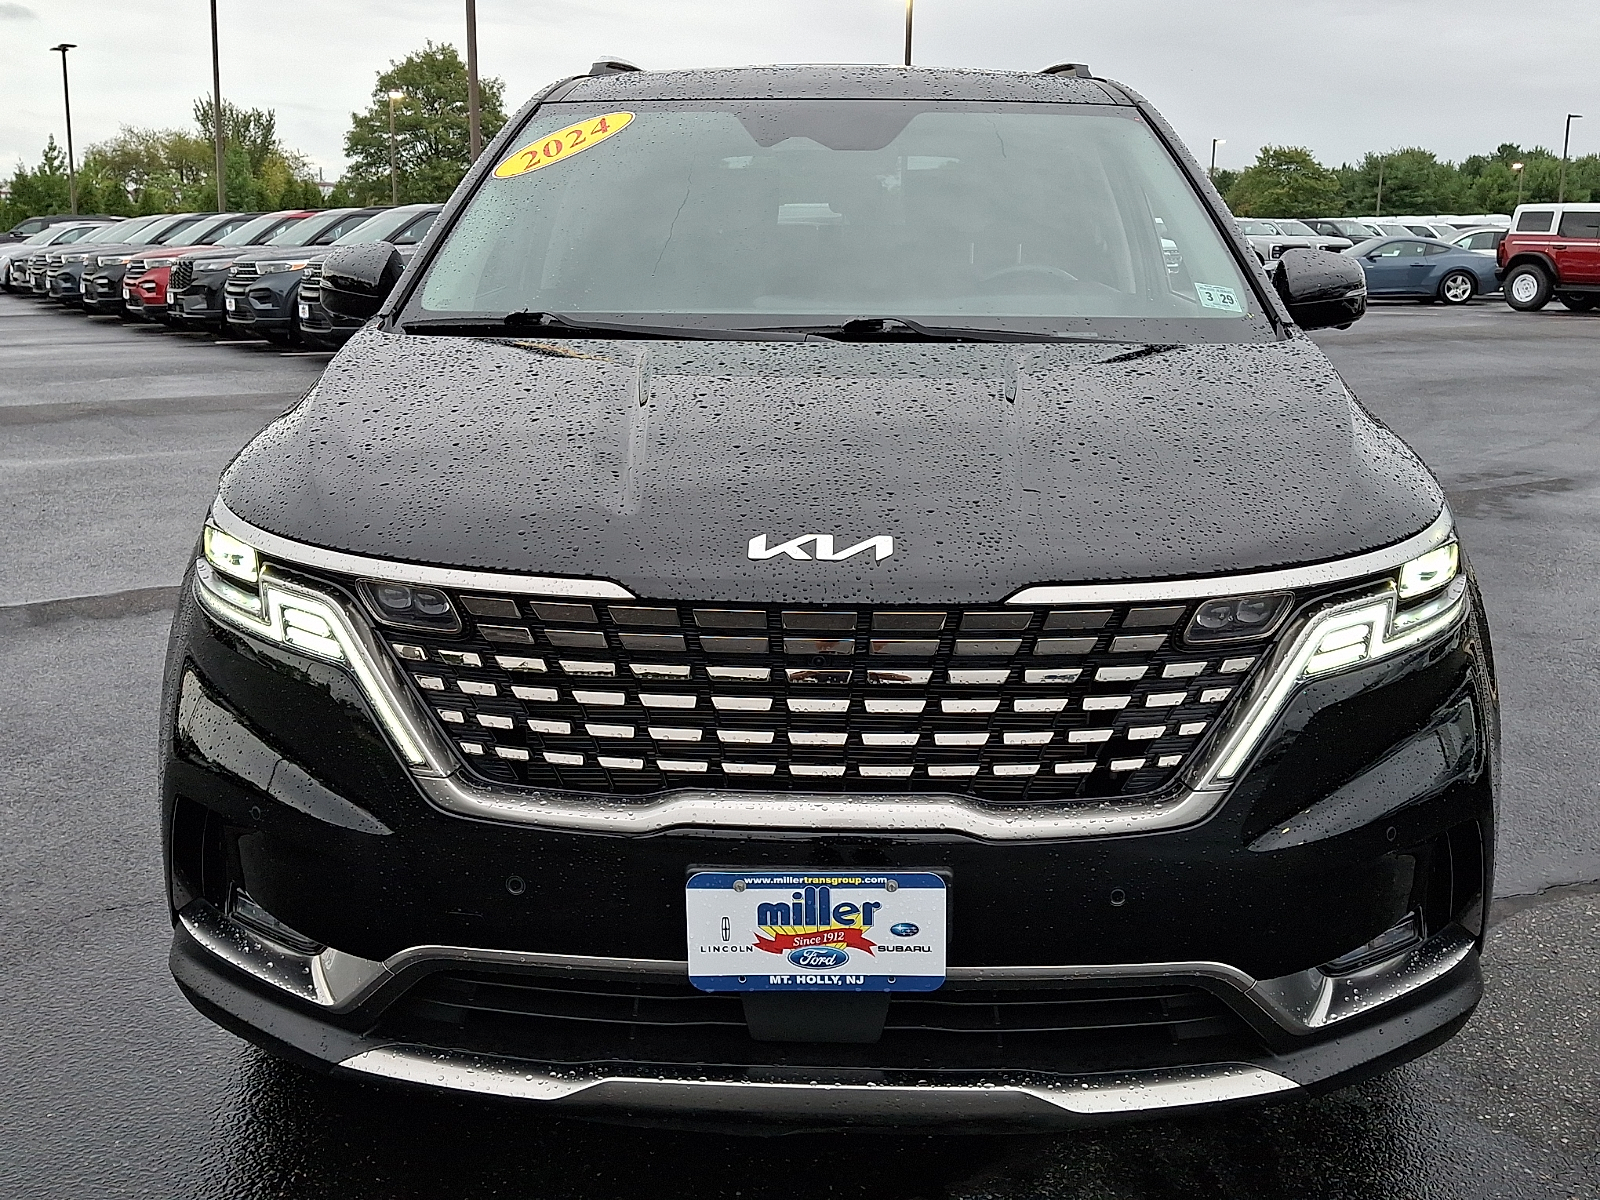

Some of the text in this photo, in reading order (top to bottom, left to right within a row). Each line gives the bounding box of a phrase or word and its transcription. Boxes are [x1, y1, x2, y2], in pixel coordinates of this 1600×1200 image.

[520, 117, 610, 170] 2024
[1205, 292, 1234, 304] 3 29
[743, 877, 887, 885] www.millertransgroup.com
[757, 886, 881, 926] miller
[793, 932, 845, 946] Since 1912
[700, 945, 753, 953] LINCOLN
[799, 948, 837, 966] Ford
[769, 975, 864, 986] MT. HOLLY, NJ
